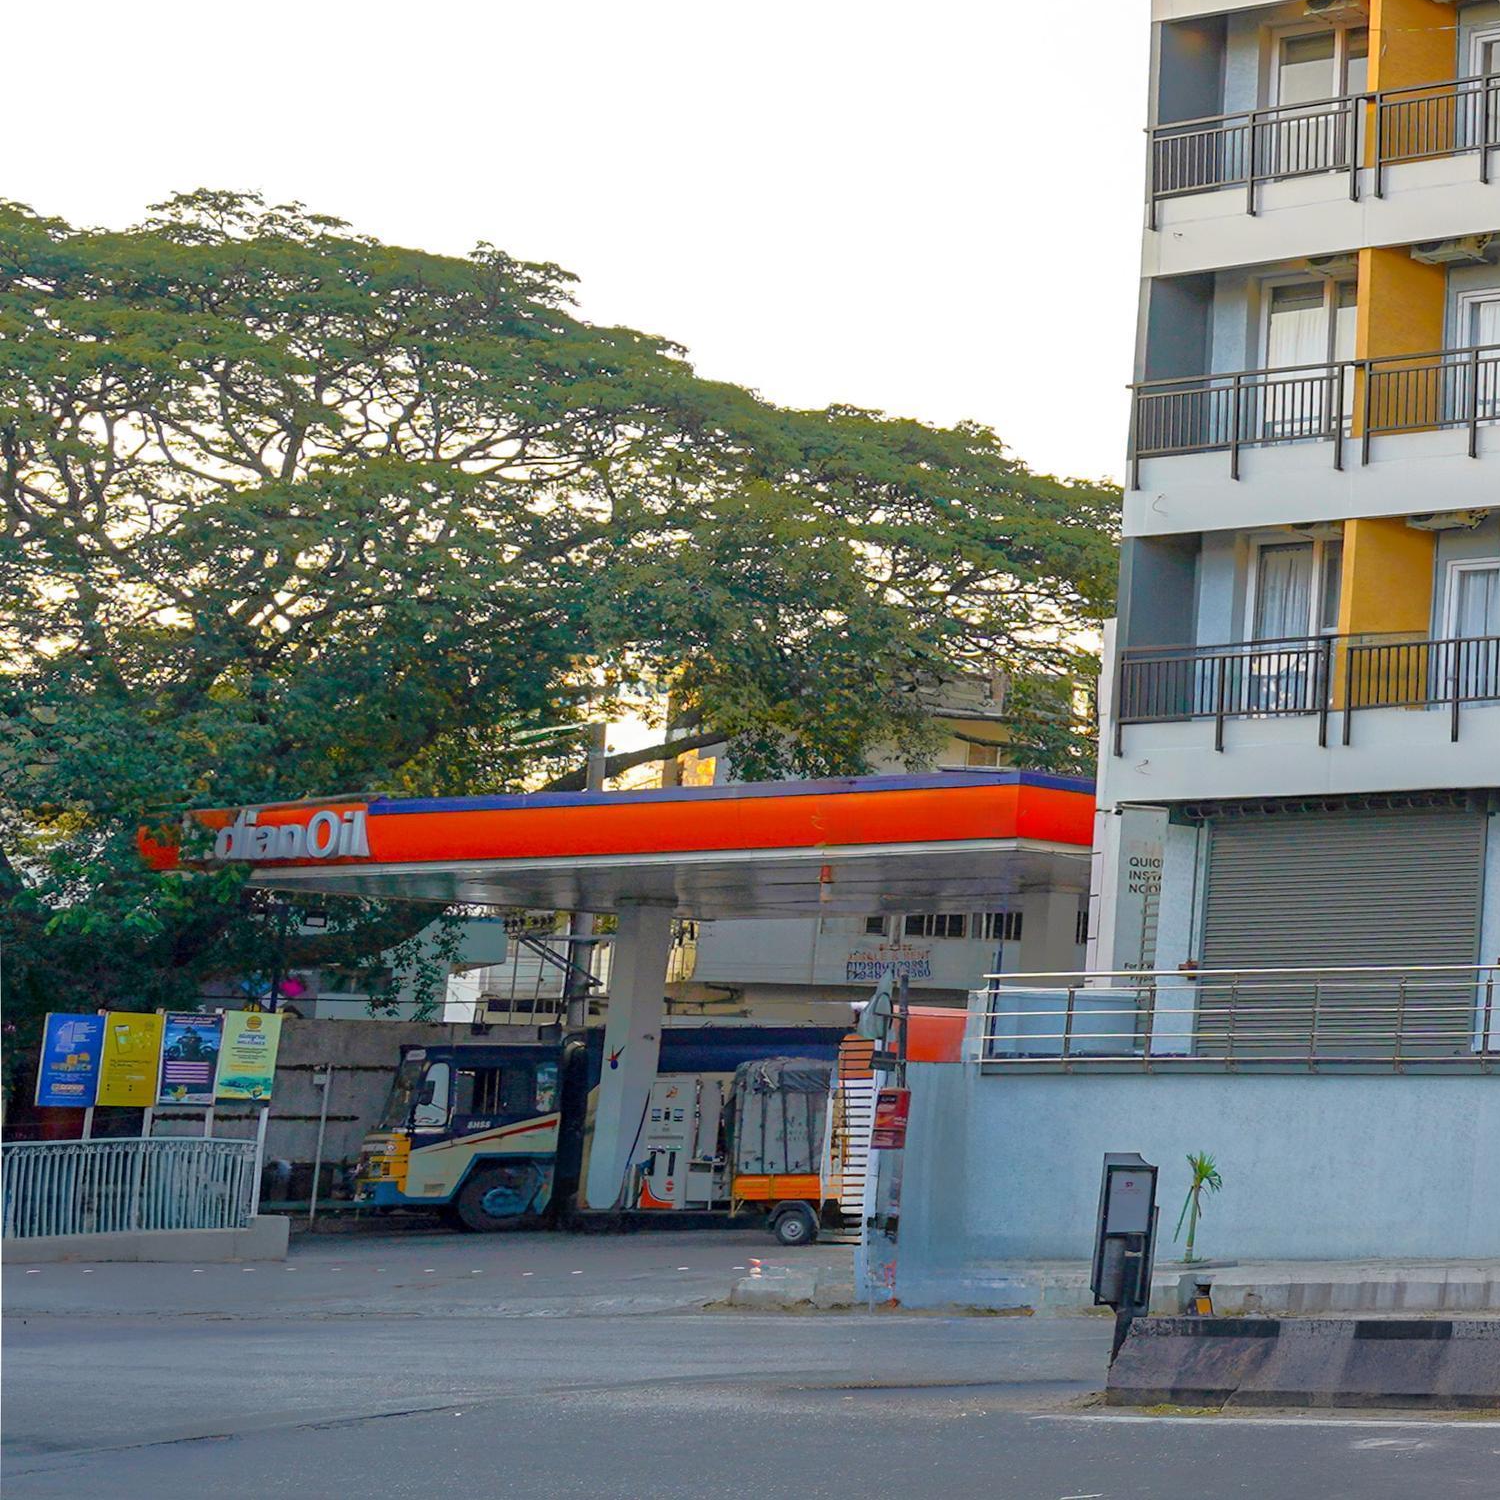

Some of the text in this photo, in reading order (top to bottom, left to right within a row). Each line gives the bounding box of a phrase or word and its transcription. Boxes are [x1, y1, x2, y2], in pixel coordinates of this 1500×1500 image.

[211, 809, 371, 860] dianOil
[1129, 856, 1163, 869] QUIC
[1128, 883, 1162, 894] NOO
